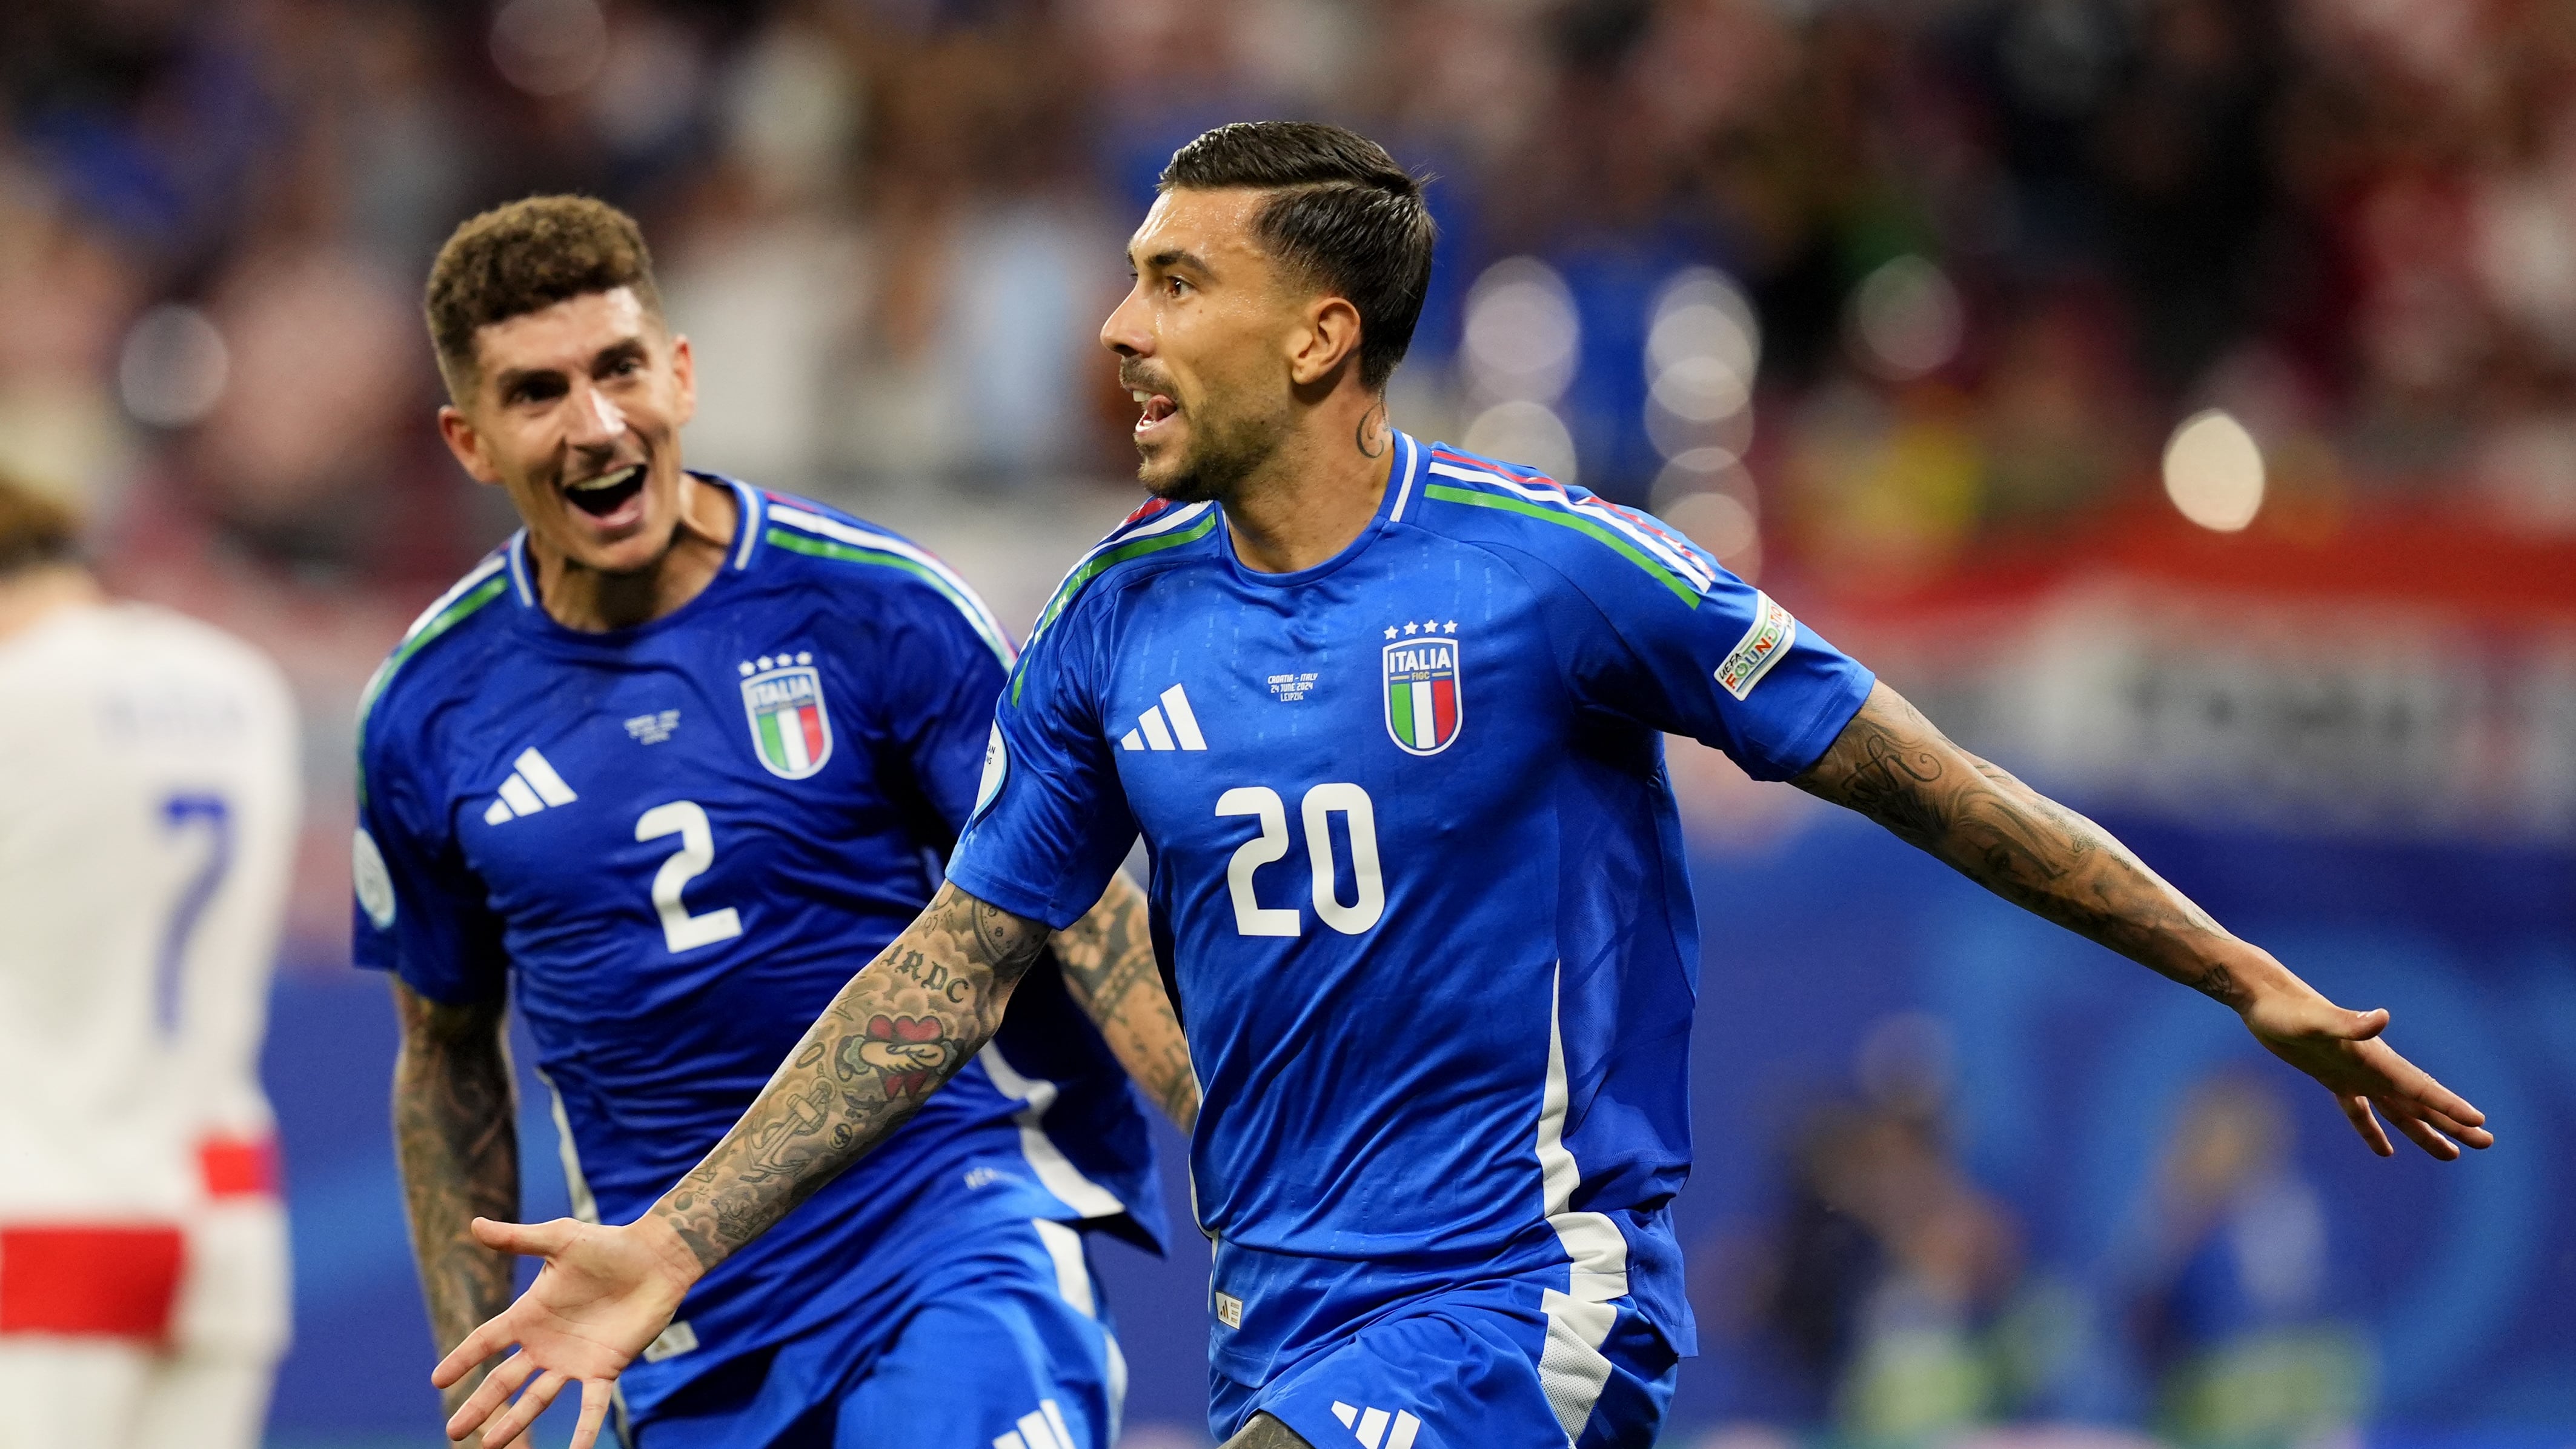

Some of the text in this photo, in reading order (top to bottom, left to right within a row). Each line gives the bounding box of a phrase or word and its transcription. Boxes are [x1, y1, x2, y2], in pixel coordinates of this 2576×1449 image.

[1725, 602, 1782, 690] FOUNDATIO
[1390, 648, 1452, 673] ITALIA
[1719, 653, 1741, 679] UEFA
[1267, 674, 1293, 684] CROATIA
[1300, 673, 1318, 682] ITALY
[1270, 682, 1313, 693] 24 JUNE 2024
[1412, 671, 1430, 681] FIGC
[1280, 691, 1304, 702] LEIPZIG
[1215, 782, 1385, 936] 20
[635, 800, 743, 953] 2
[155, 793, 236, 1036] 7
